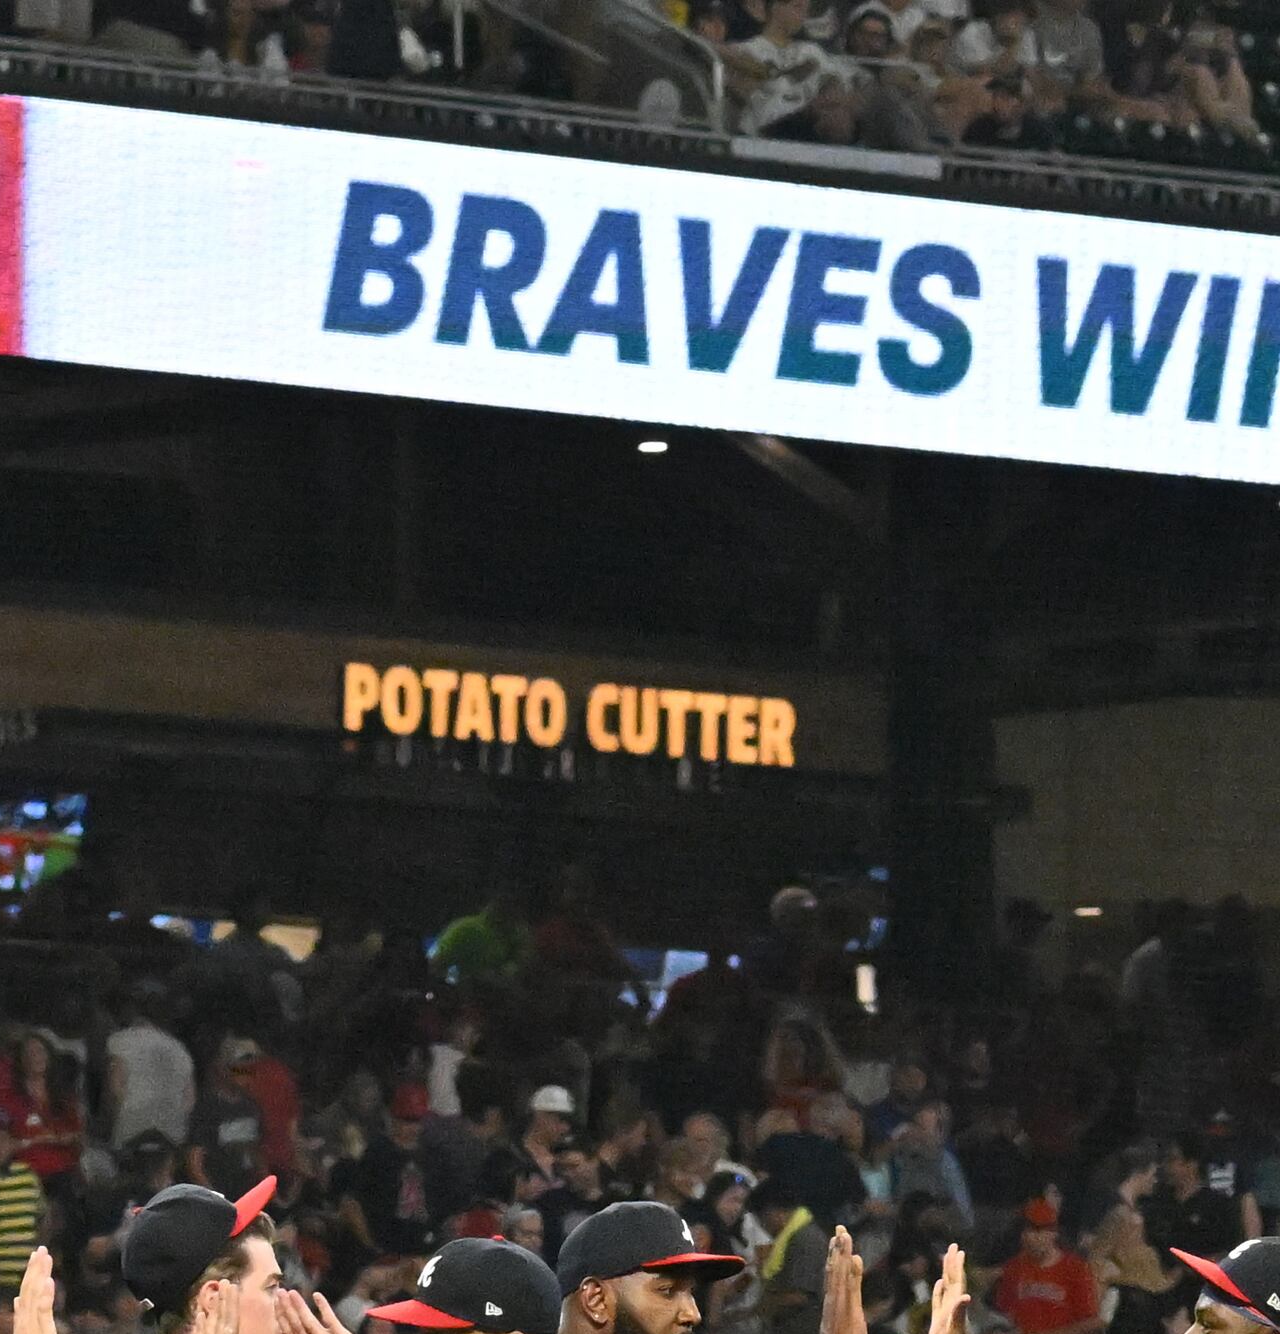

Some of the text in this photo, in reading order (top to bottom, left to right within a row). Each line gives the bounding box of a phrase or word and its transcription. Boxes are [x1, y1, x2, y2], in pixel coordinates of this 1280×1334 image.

[321, 180, 981, 396] BRAVES
[342, 662, 797, 768] POTATO CUTTER
